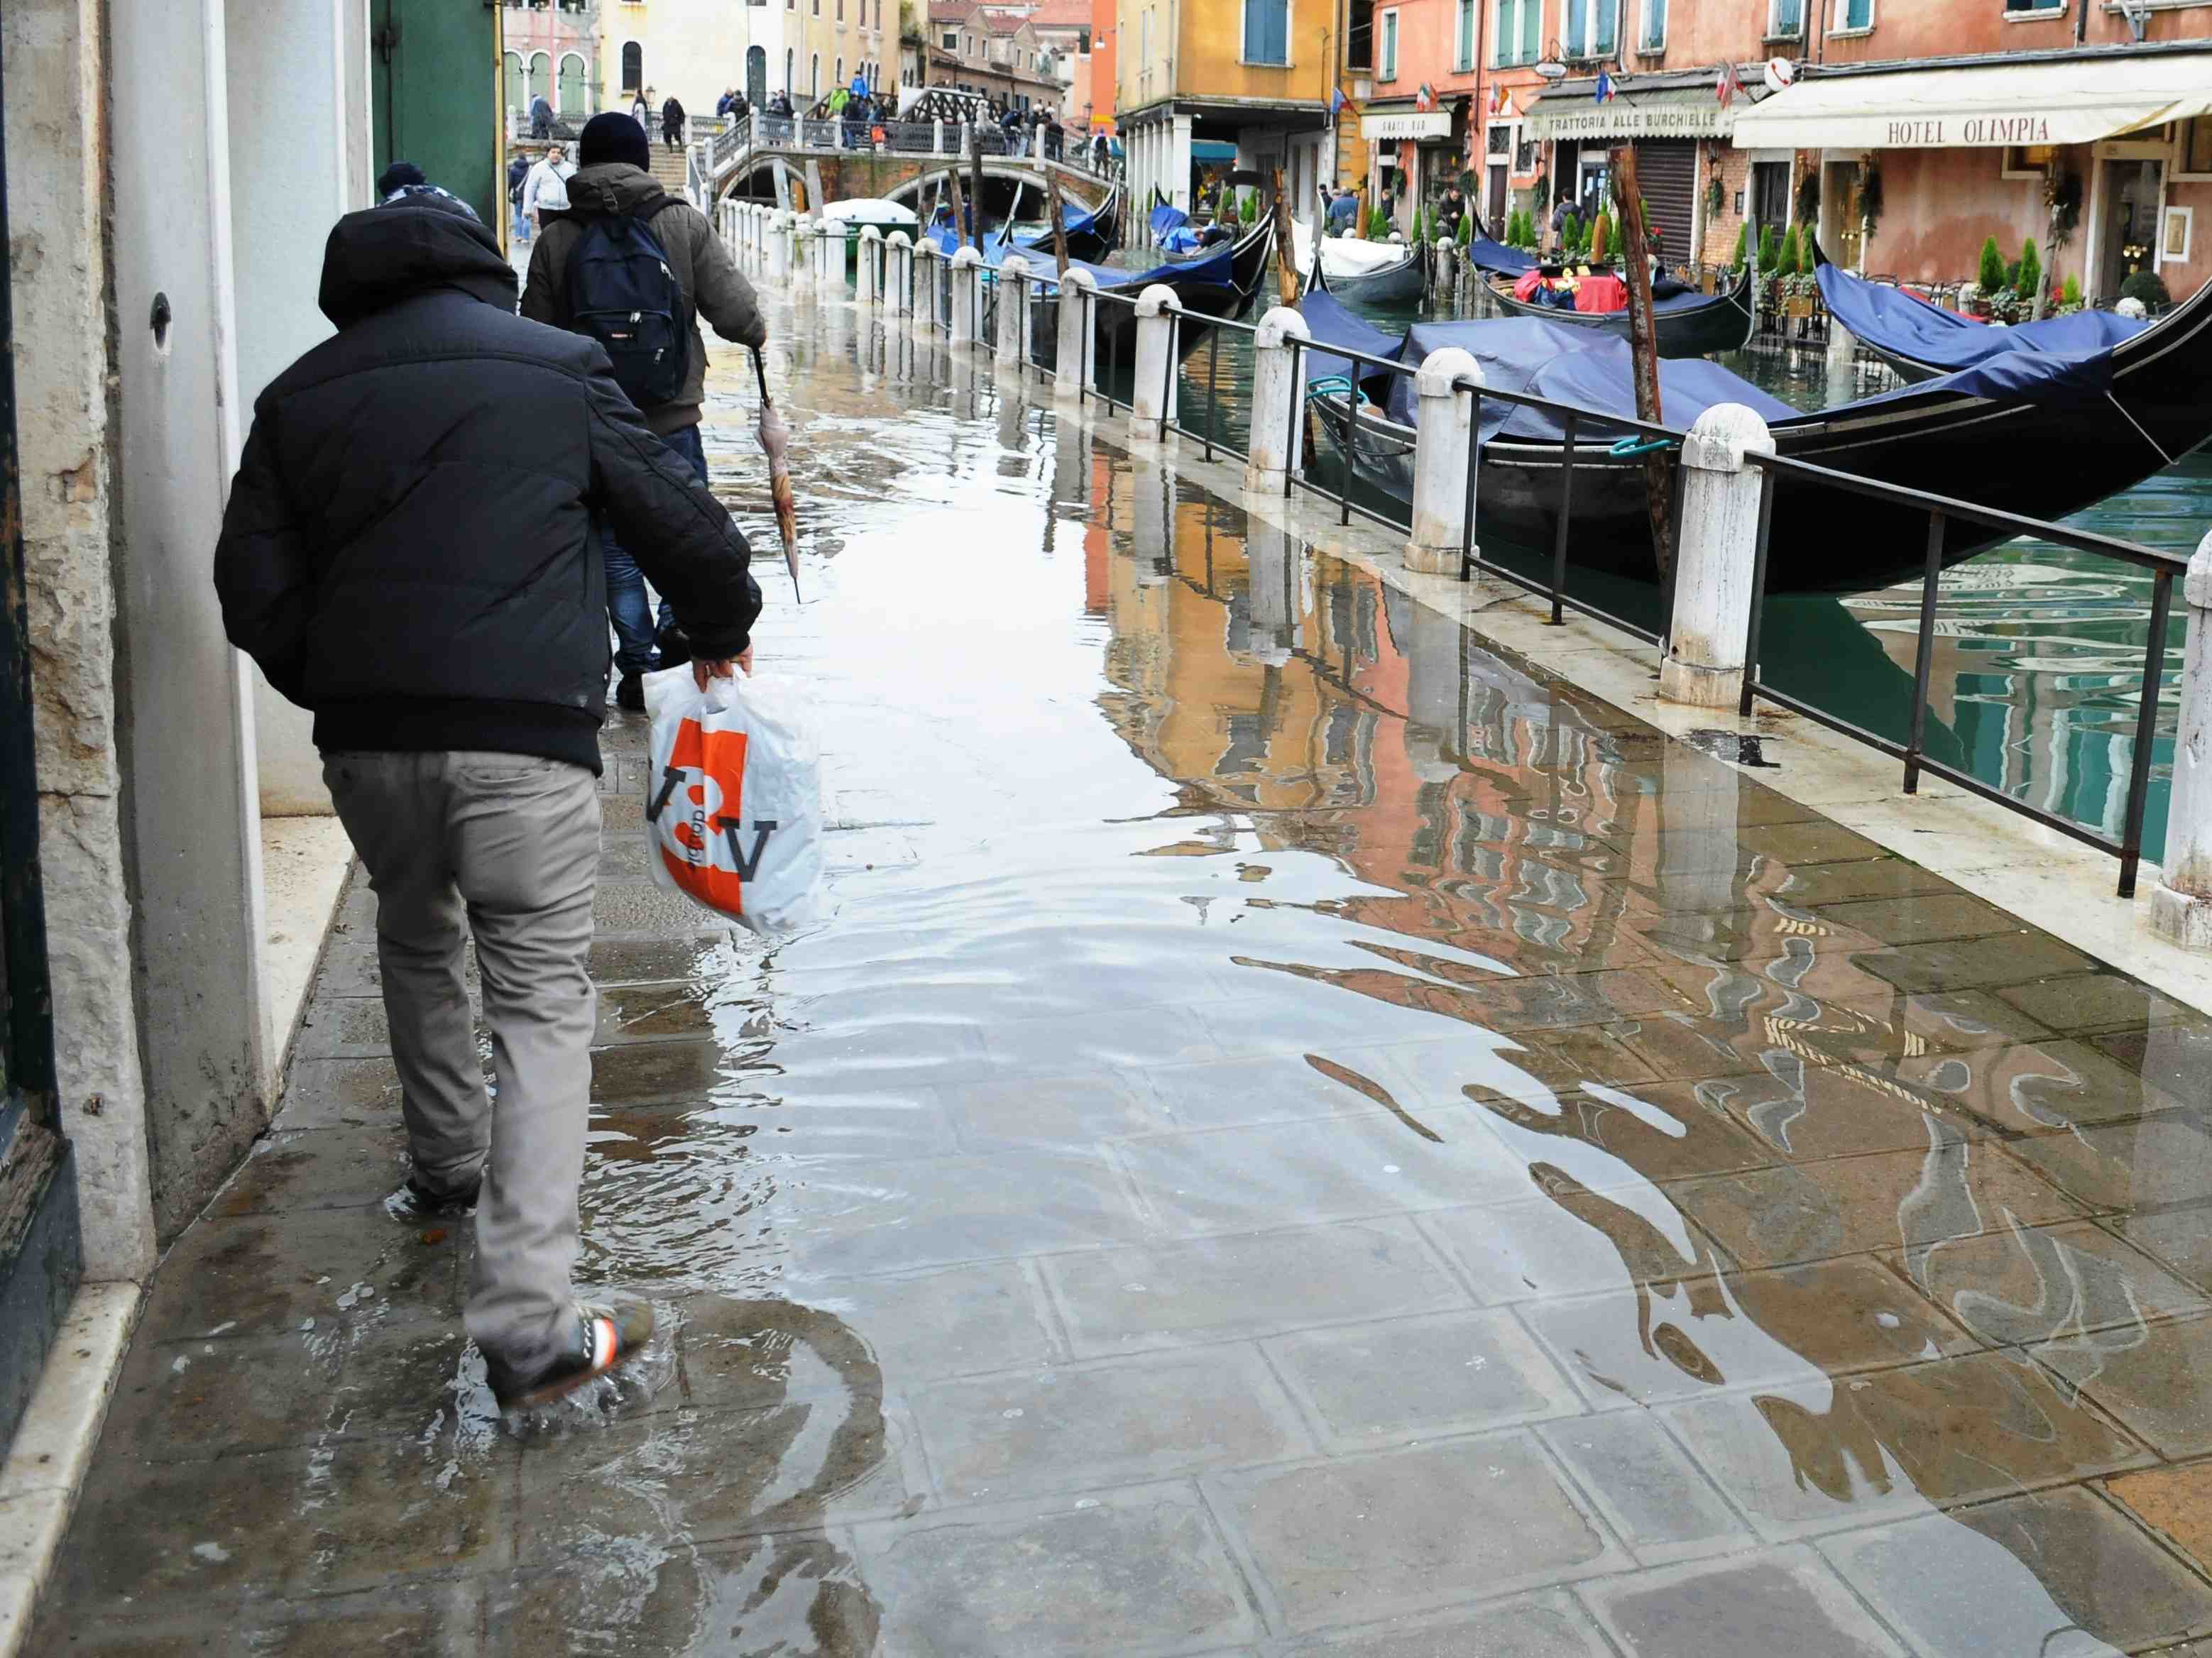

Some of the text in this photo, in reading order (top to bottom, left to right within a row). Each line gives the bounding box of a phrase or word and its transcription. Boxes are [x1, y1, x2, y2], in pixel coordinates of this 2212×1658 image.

[1550, 116, 1605, 131] TRATTORIA
[1614, 114, 1640, 128] ALLE
[1646, 113, 1716, 127] BURCHIELLE
[1888, 117, 2049, 143] HOTEL OLIMPIA
